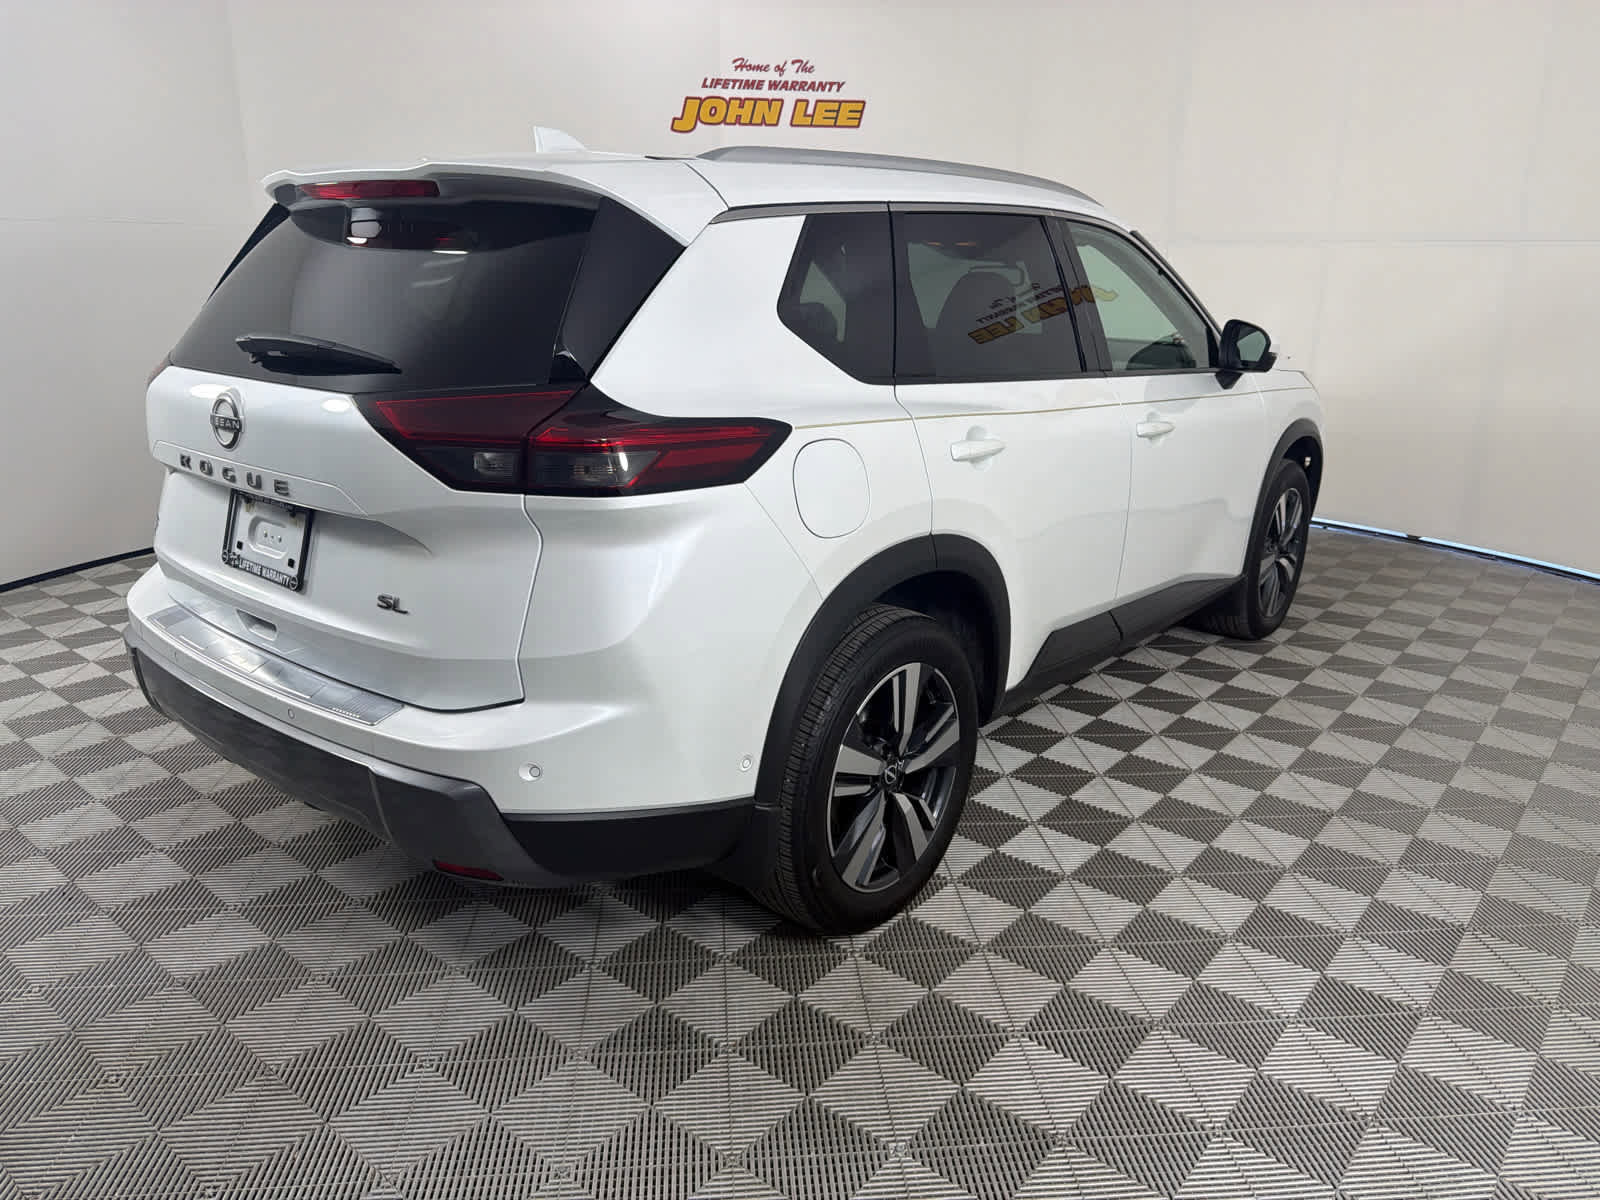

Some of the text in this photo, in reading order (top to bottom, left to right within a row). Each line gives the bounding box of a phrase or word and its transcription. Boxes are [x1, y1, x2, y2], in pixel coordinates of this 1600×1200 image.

[732, 57, 815, 77] Home of The
[701, 77, 846, 92] LIFETIME WARRANTY
[670, 96, 866, 133] JOHN LEE
[180, 454, 289, 496] ROGUE
[239, 559, 290, 585] LIFETIME WARRANTY
[377, 594, 408, 614] SL
